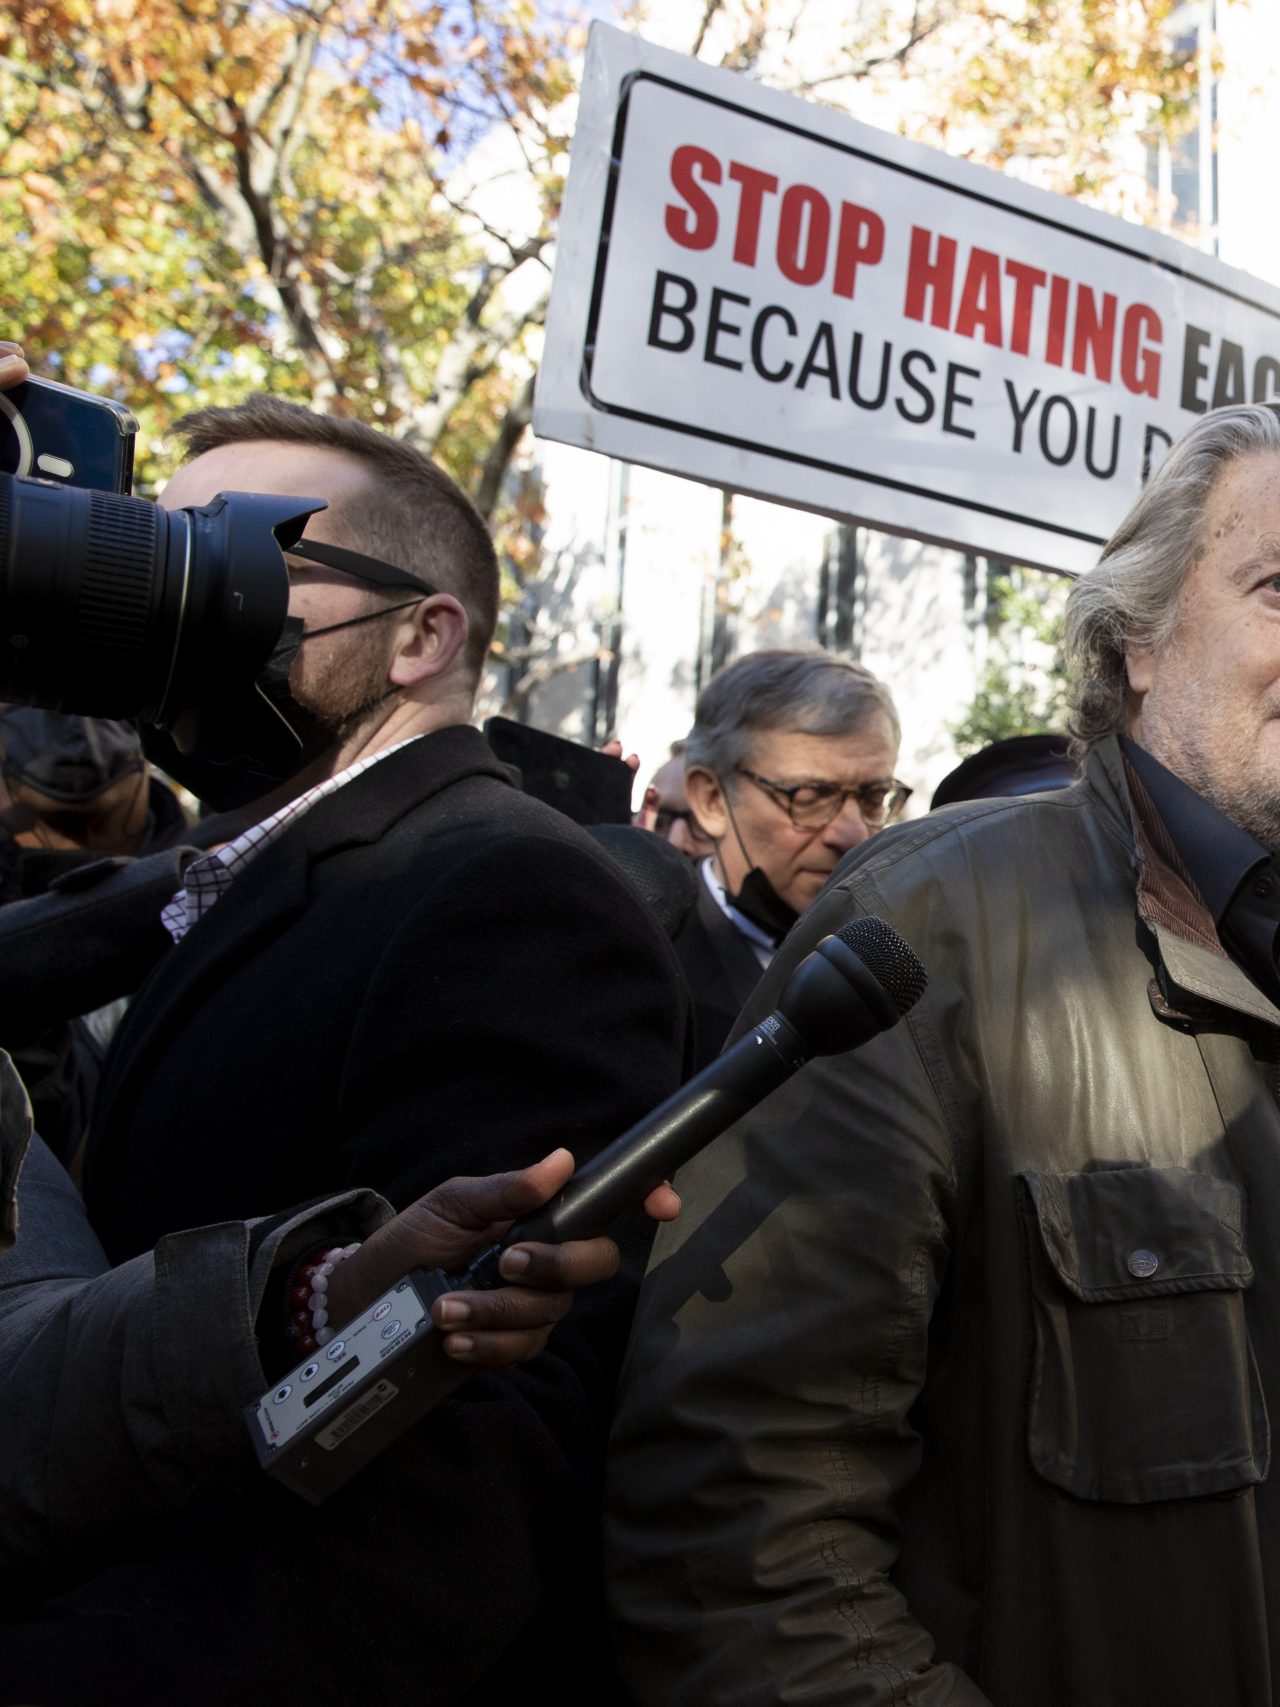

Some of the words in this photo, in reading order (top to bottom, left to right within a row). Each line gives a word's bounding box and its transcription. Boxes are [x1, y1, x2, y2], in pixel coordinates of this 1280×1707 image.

[664, 144, 885, 299] STOP
[903, 225, 1163, 400] HATING
[647, 269, 981, 440] BECAUSE
[1003, 379, 1121, 480] YOU
[328, 1344, 341, 1355] ON
[373, 1303, 390, 1319] OFF
